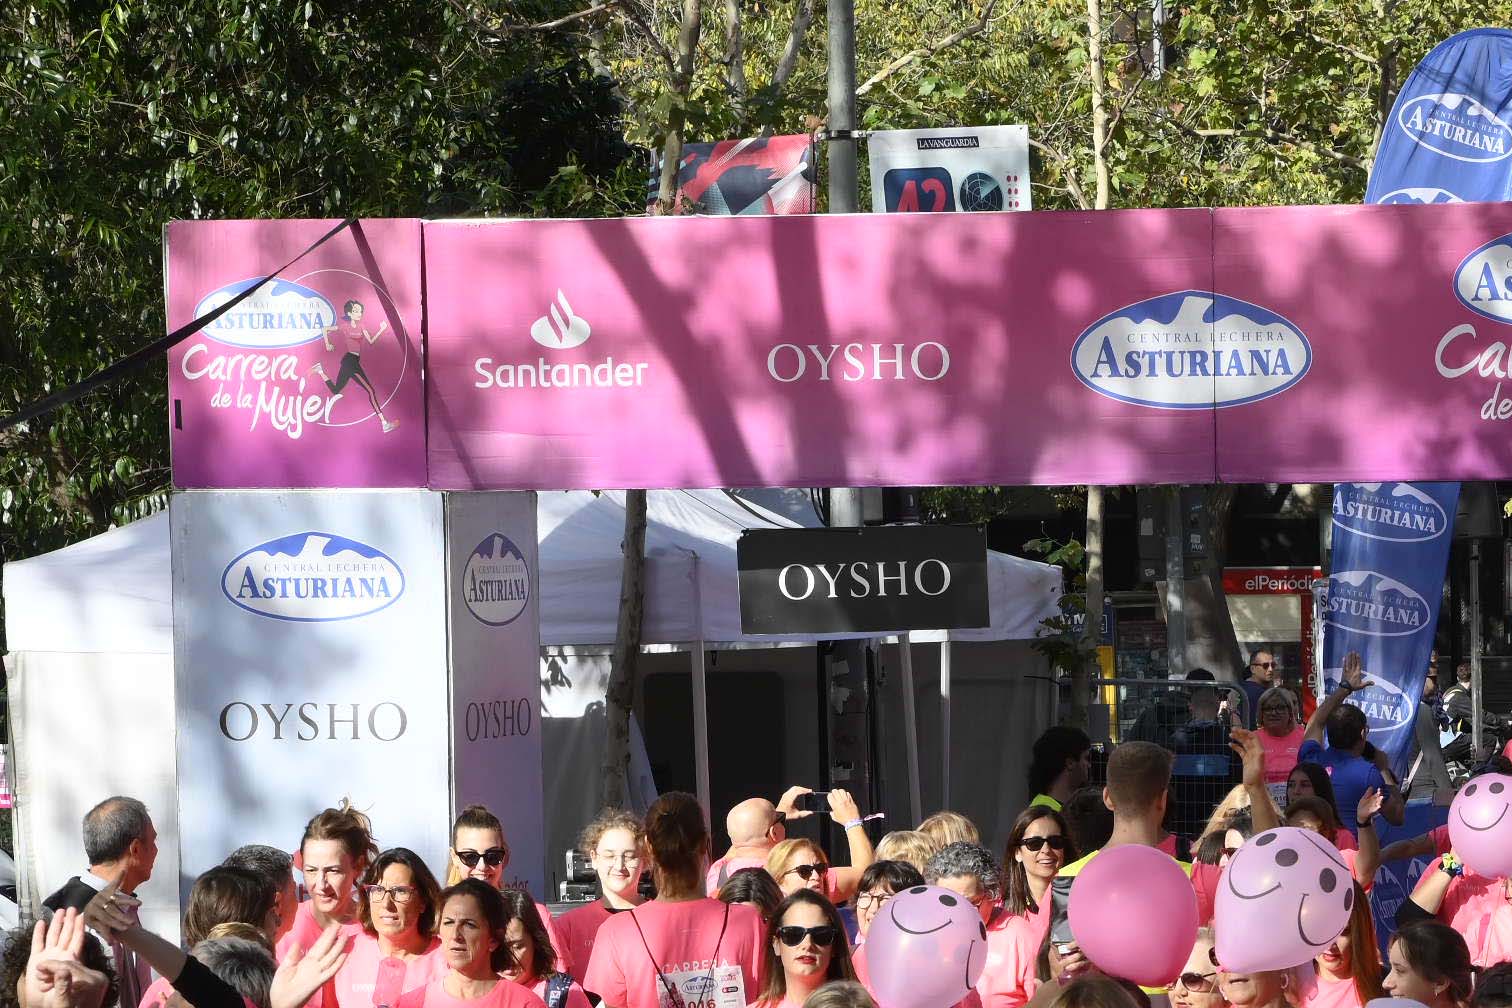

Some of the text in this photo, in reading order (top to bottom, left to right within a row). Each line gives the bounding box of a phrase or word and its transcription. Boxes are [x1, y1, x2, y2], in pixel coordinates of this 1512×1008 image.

[1406, 105, 1504, 154] ASTURIANA
[1090, 335, 1293, 378] ASTURIANA
[1127, 331, 1285, 344] CENTRAL LECHERA
[182, 343, 299, 381] Carrera
[474, 357, 648, 389] Santander
[767, 341, 951, 382] OYSHO
[210, 379, 343, 439] de la Mujer
[1332, 489, 1437, 534] ASTURIANA
[237, 566, 392, 600] ASTURIANA
[263, 562, 321, 573] CENTRAL
[468, 567, 526, 603] ASTURIANA
[778, 559, 951, 601] OYSHO
[1330, 596, 1420, 627] STURIANA
[218, 701, 408, 741] OYSHO
[464, 697, 532, 742] OYSHO
